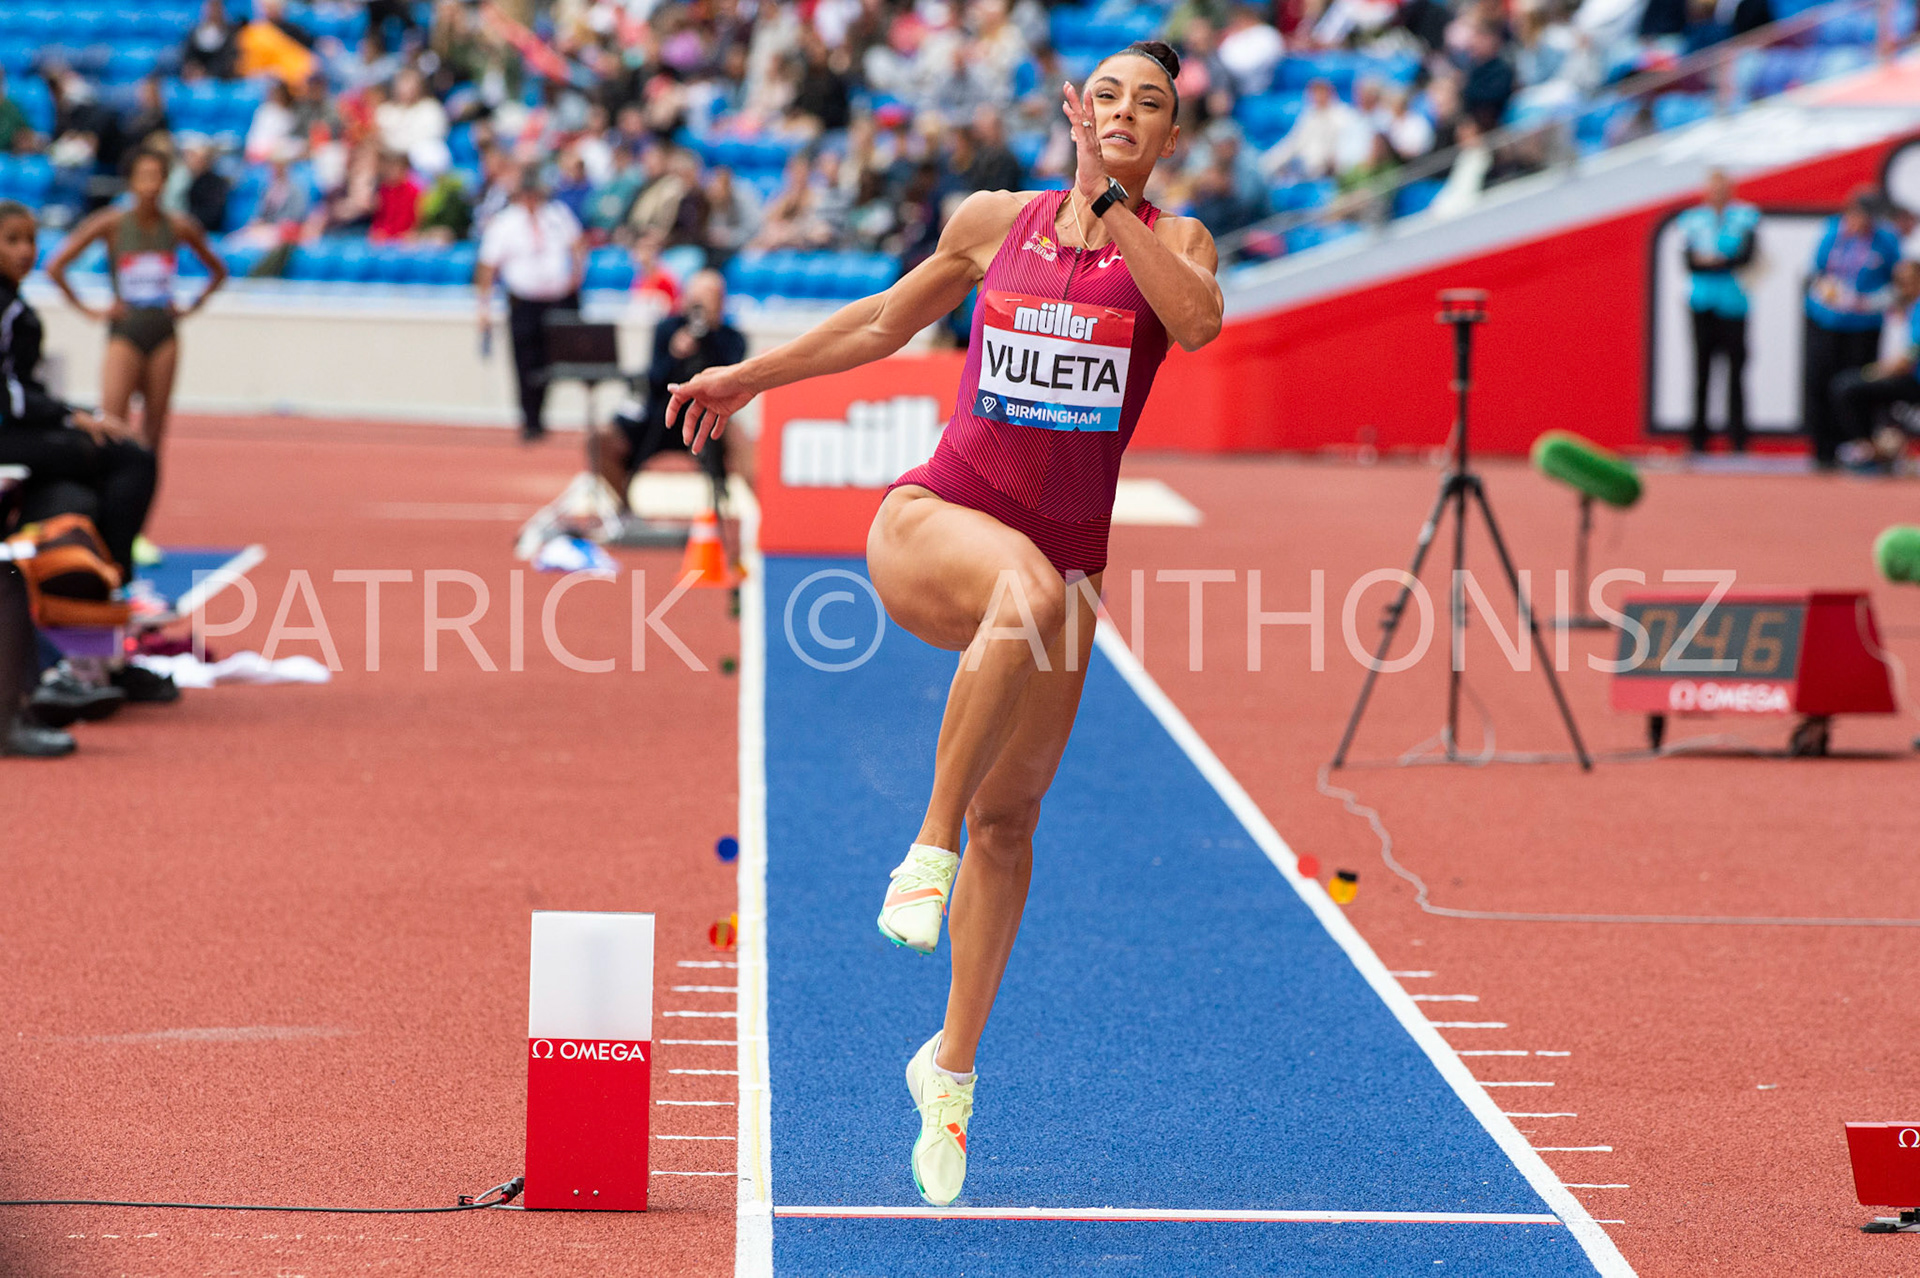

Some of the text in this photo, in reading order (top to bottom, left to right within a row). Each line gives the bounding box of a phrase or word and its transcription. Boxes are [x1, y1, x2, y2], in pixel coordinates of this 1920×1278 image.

[1013, 302, 1099, 342] müller
[986, 340, 1120, 394] VULETA
[1006, 403, 1101, 425] BIRMINGHAM
[781, 396, 949, 488] müll
[560, 1041, 645, 1062] OMEGA
